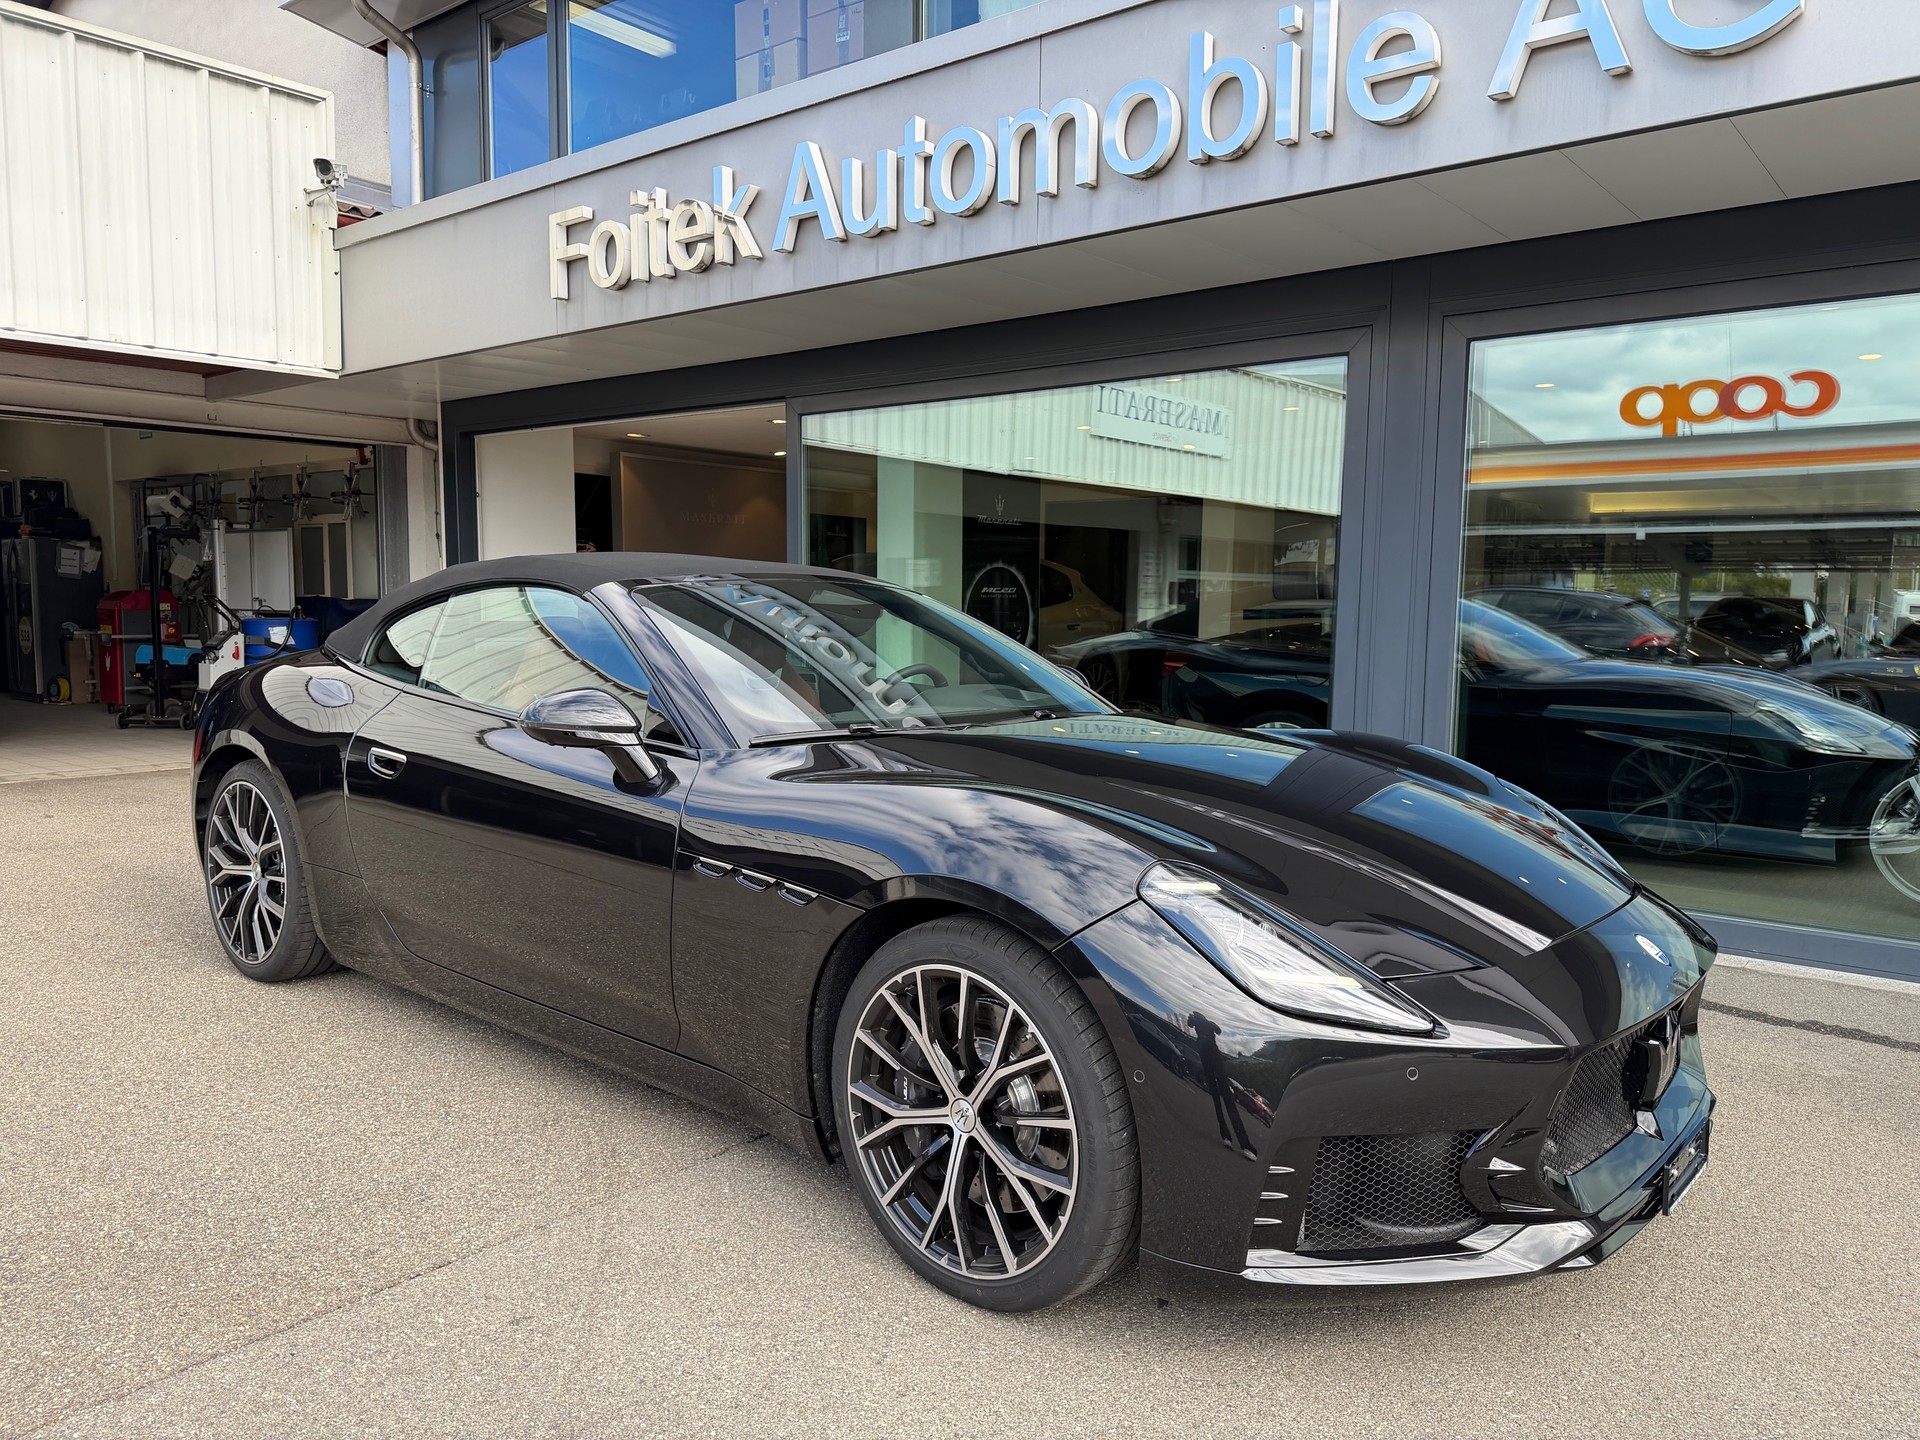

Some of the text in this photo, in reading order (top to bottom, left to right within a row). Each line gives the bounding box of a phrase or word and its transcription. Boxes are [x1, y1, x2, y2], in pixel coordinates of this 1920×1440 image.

[549, 165, 763, 301] Foitek
[772, 0, 1442, 252] Automobile
[977, 514, 1022, 526] Maserati
[981, 586, 1017, 594] MC20
